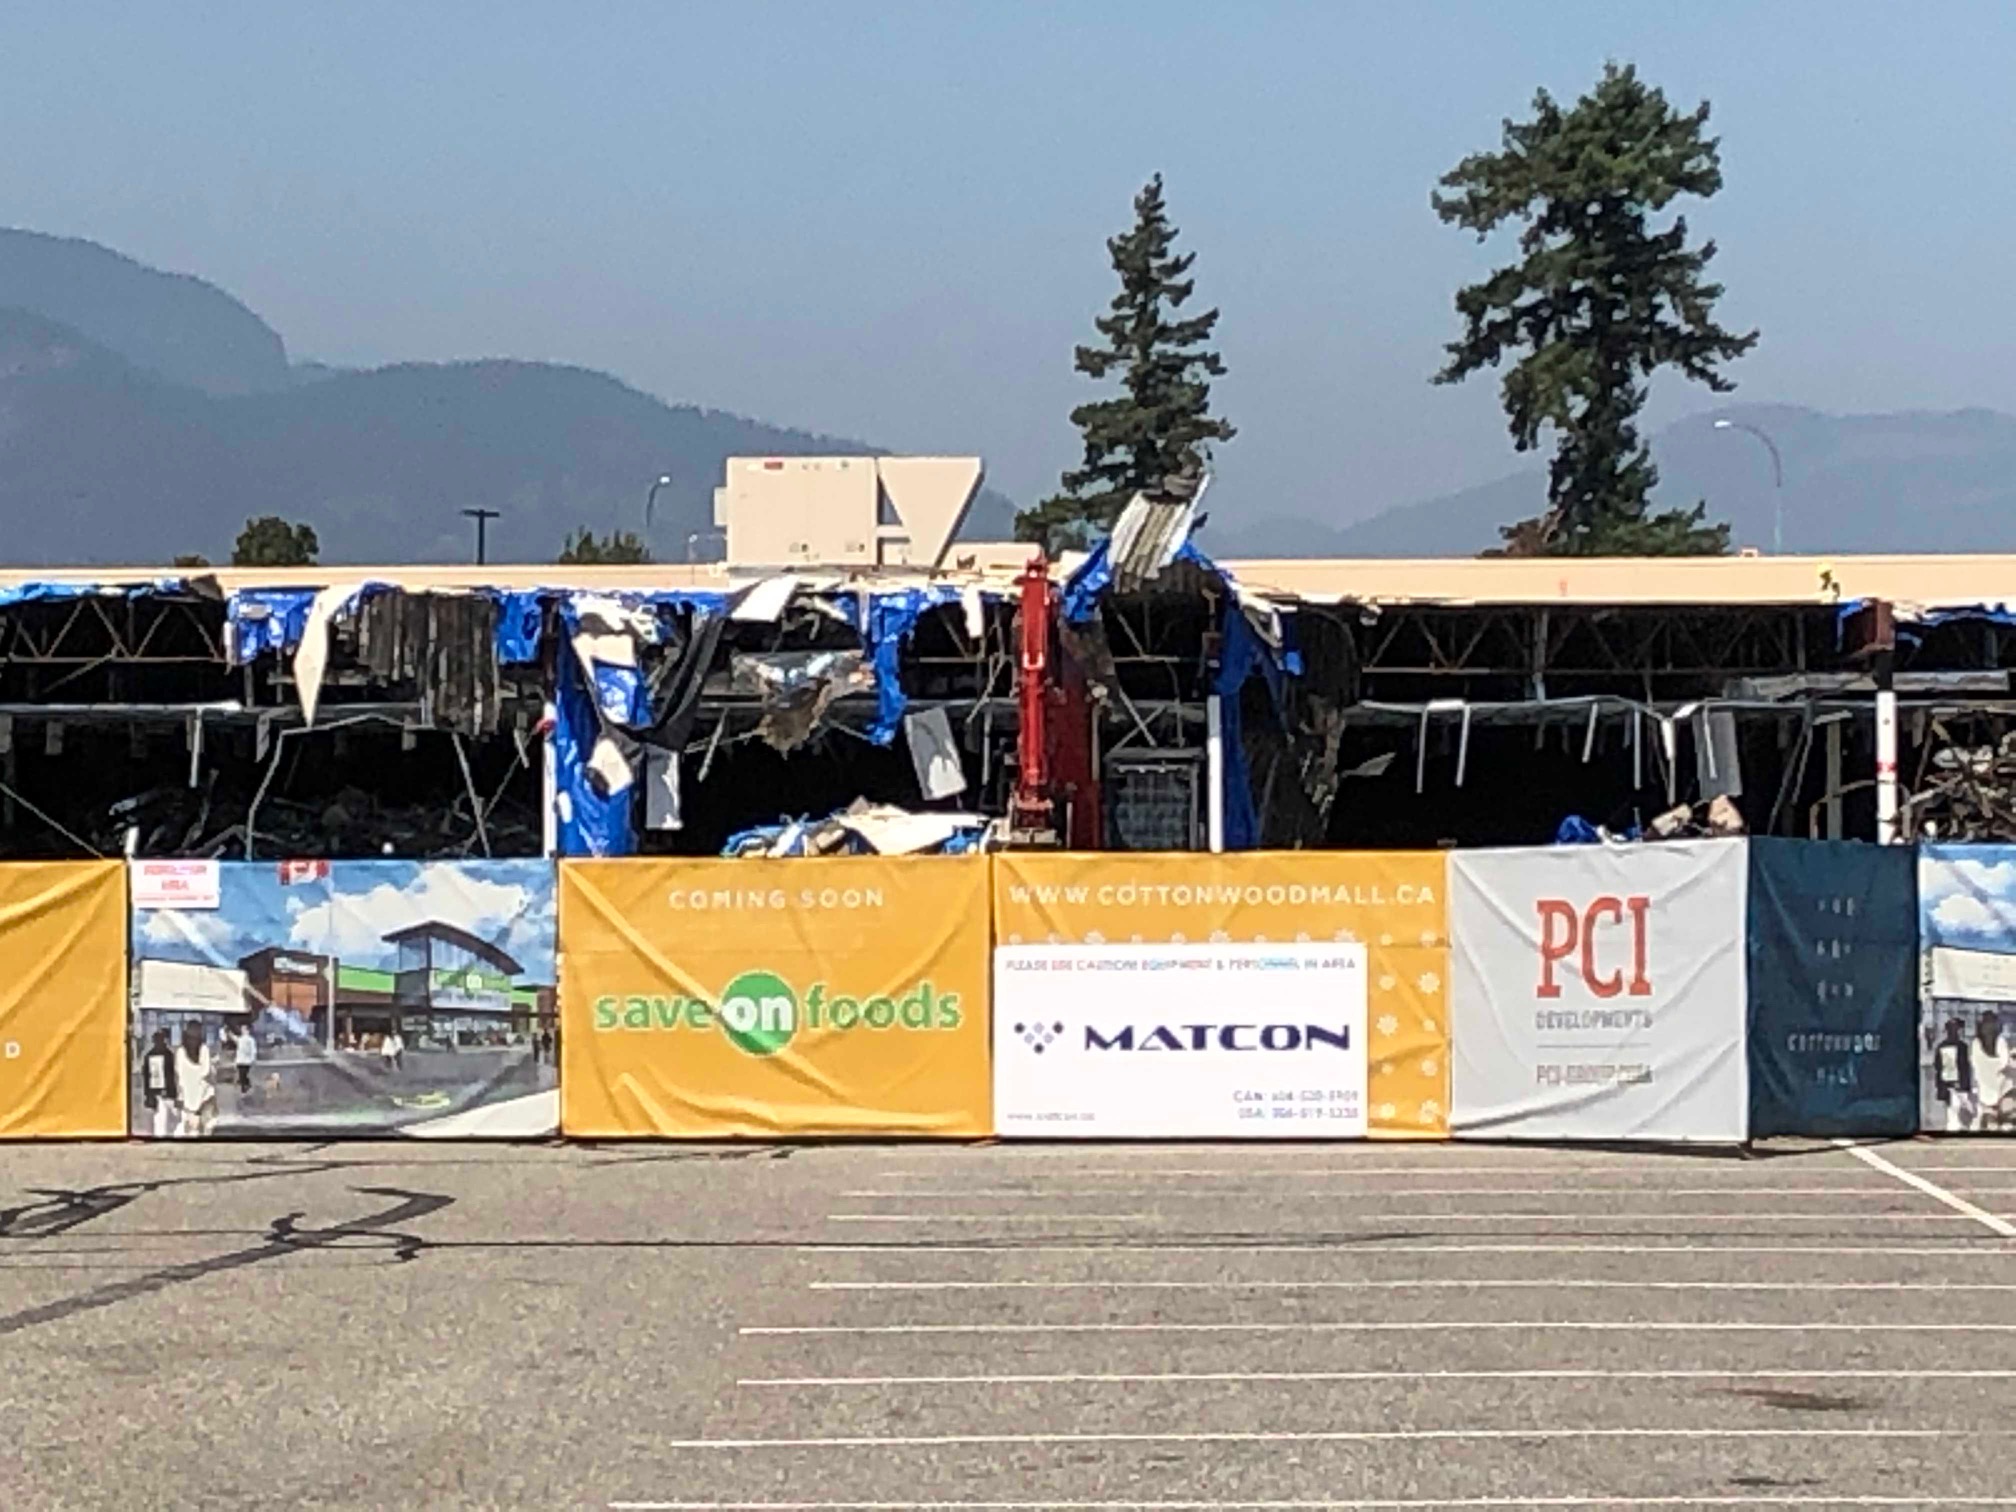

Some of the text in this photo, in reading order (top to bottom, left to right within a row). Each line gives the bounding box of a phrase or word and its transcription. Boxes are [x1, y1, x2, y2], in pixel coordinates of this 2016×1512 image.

[669, 887, 884, 910] COMING SOON
[1536, 896, 1652, 998] PCI
[595, 982, 962, 1032] save on foods
[5, 1041, 20, 1059] D
[1085, 1025, 1350, 1051] MATCON
